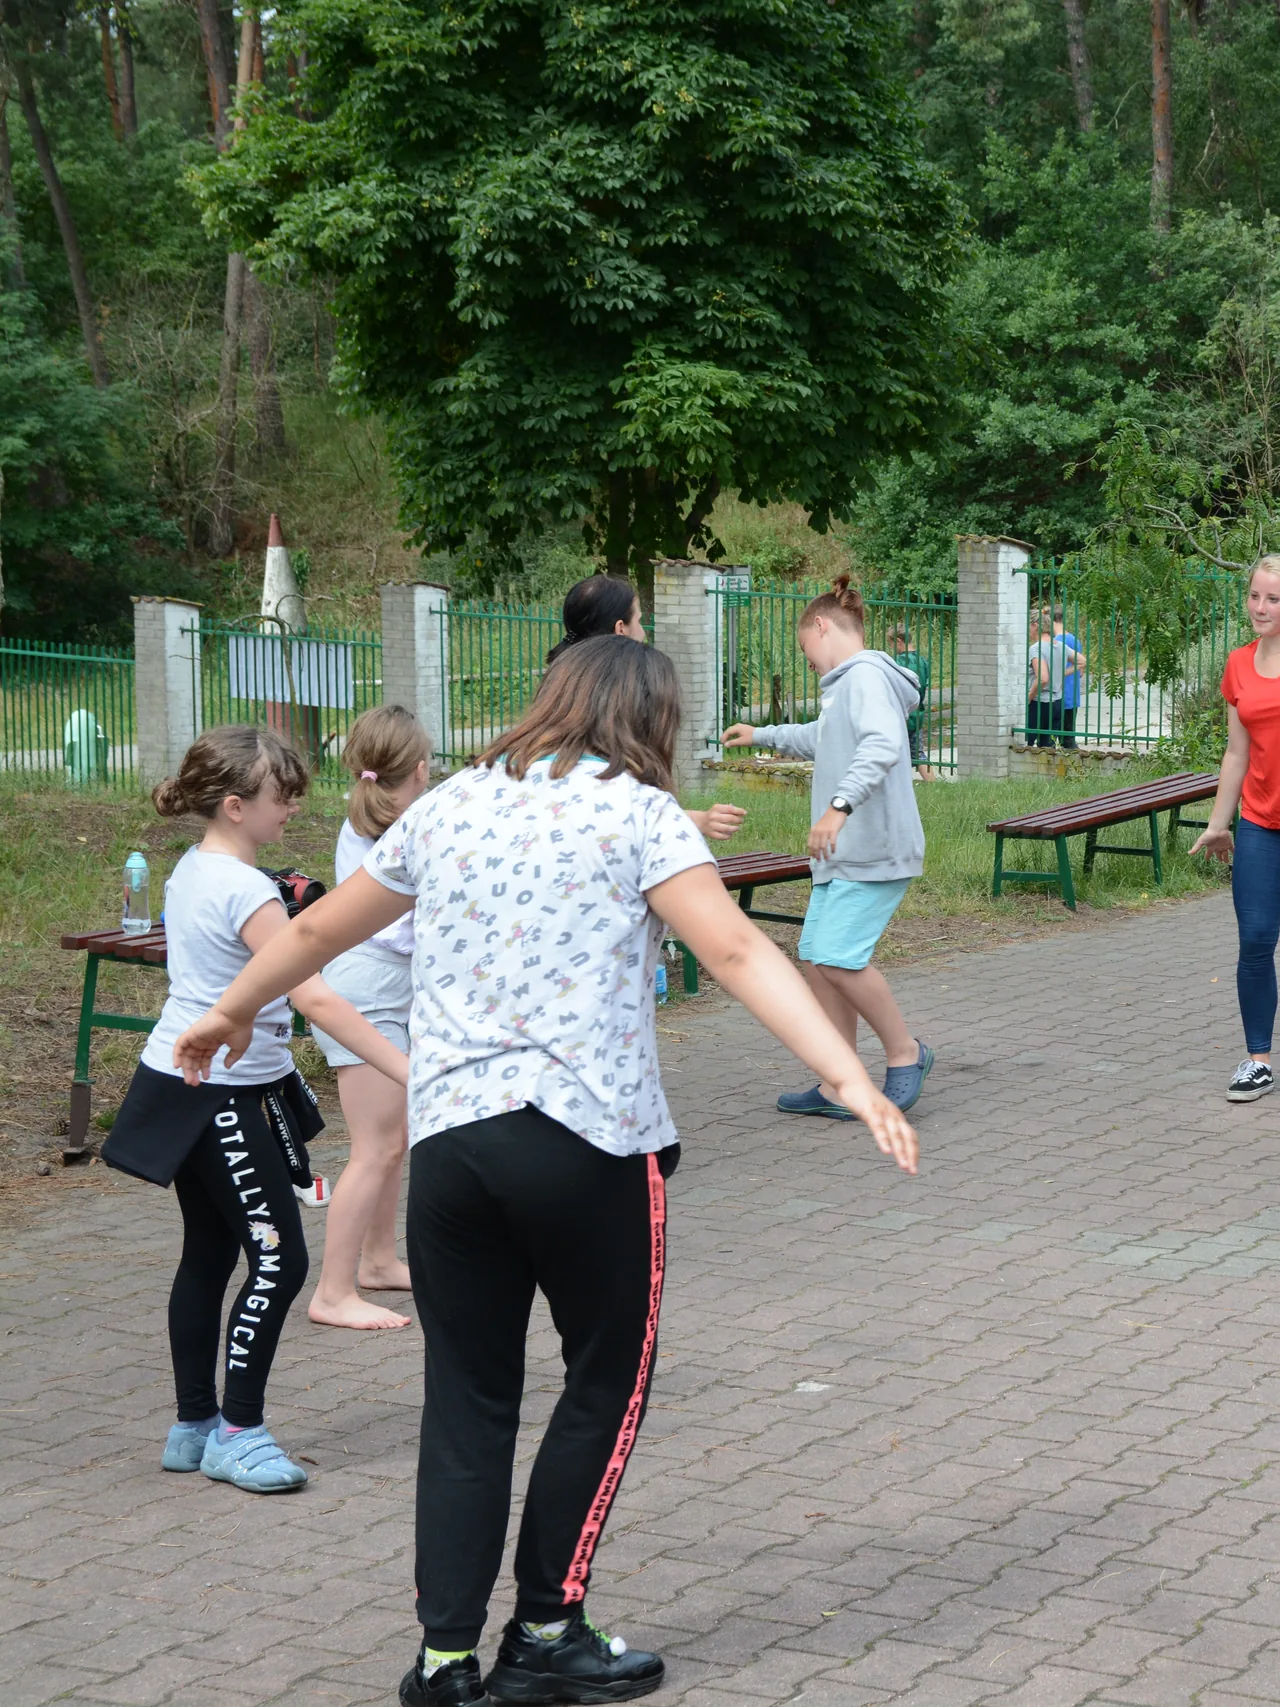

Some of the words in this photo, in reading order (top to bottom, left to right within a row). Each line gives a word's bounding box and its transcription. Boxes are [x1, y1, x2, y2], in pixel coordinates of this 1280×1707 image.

[214, 1097, 271, 1217] OTALLY
[268, 1097, 279, 1116] NYC
[278, 1122, 289, 1141] NYC
[286, 1147, 298, 1167] NYC
[228, 1254, 281, 1370] MAGICAL
[618, 1401, 640, 1456] BATMAN
[592, 1467, 619, 1521] BATMAN
